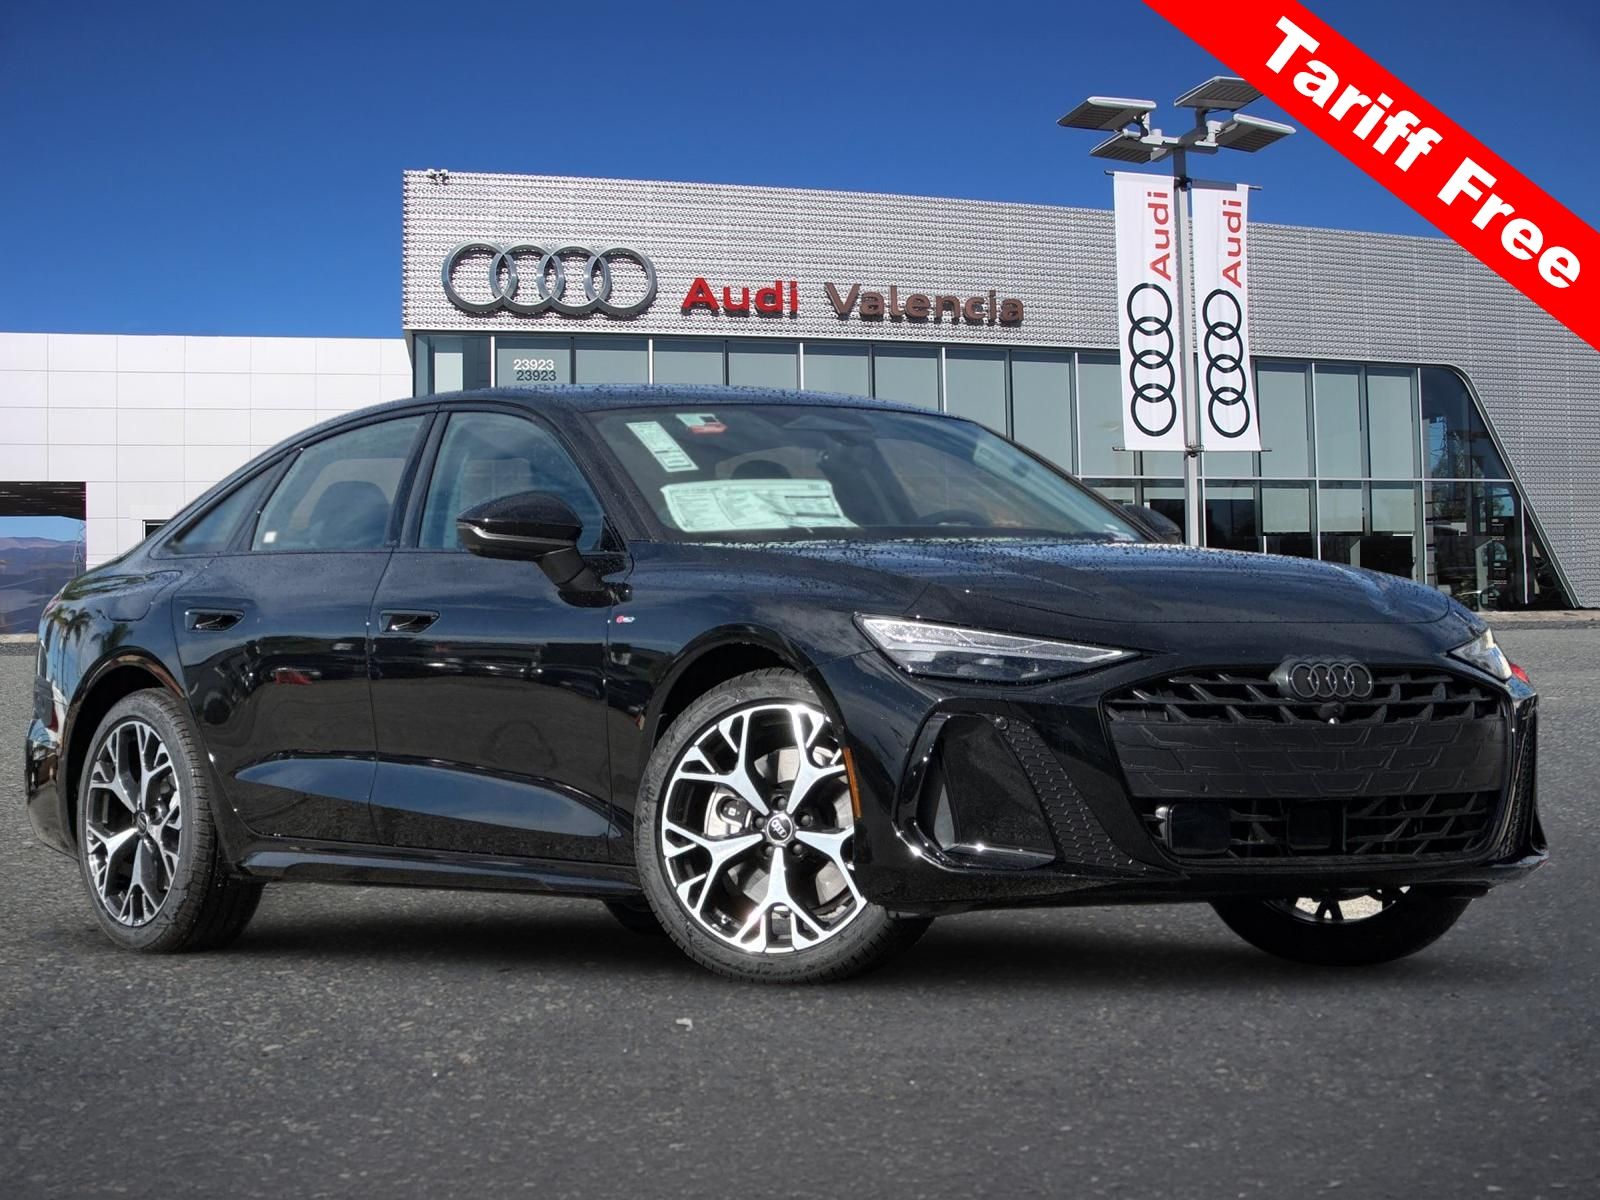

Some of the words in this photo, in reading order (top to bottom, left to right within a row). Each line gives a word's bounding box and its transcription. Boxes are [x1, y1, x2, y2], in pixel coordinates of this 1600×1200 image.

[1147, 191, 1172, 281] Audi
[1222, 200, 1242, 288] Audi
[681, 276, 799, 318] Audi
[824, 281, 1025, 326] Valencia
[513, 359, 554, 370] 23923
[516, 370, 557, 381] 23923
